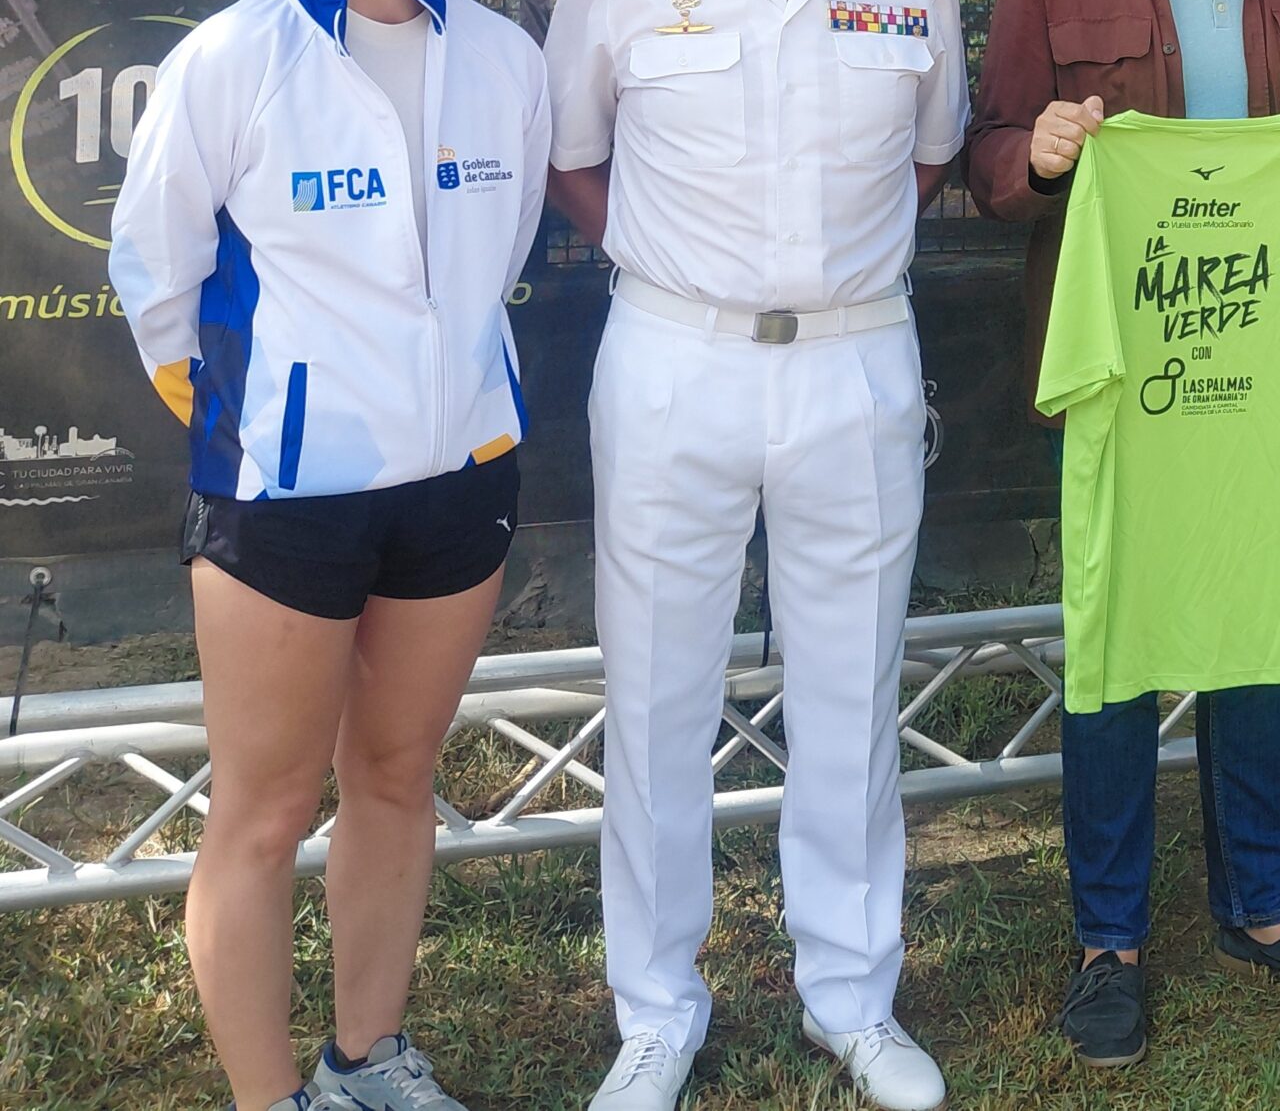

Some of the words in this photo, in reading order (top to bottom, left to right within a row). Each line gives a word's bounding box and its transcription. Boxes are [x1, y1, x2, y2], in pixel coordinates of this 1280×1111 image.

[327, 168, 386, 201] FCA
[464, 171, 478, 183] de
[1171, 197, 1241, 218] Binter
[1145, 235, 1176, 262] LA
[1134, 243, 1276, 313] MAREA
[1164, 299, 1261, 343] VERDE
[1191, 346, 1212, 360] CON
[1183, 379, 1204, 394] LAS
[1206, 376, 1253, 393] PALMAS
[1182, 395, 1191, 403] DE
[1192, 394, 1210, 403] GRAN
[13, 470, 26, 478] TU
[29, 468, 72, 478] CIUDAD
[73, 466, 102, 475] PARA
[104, 463, 133, 473] VIVIR
